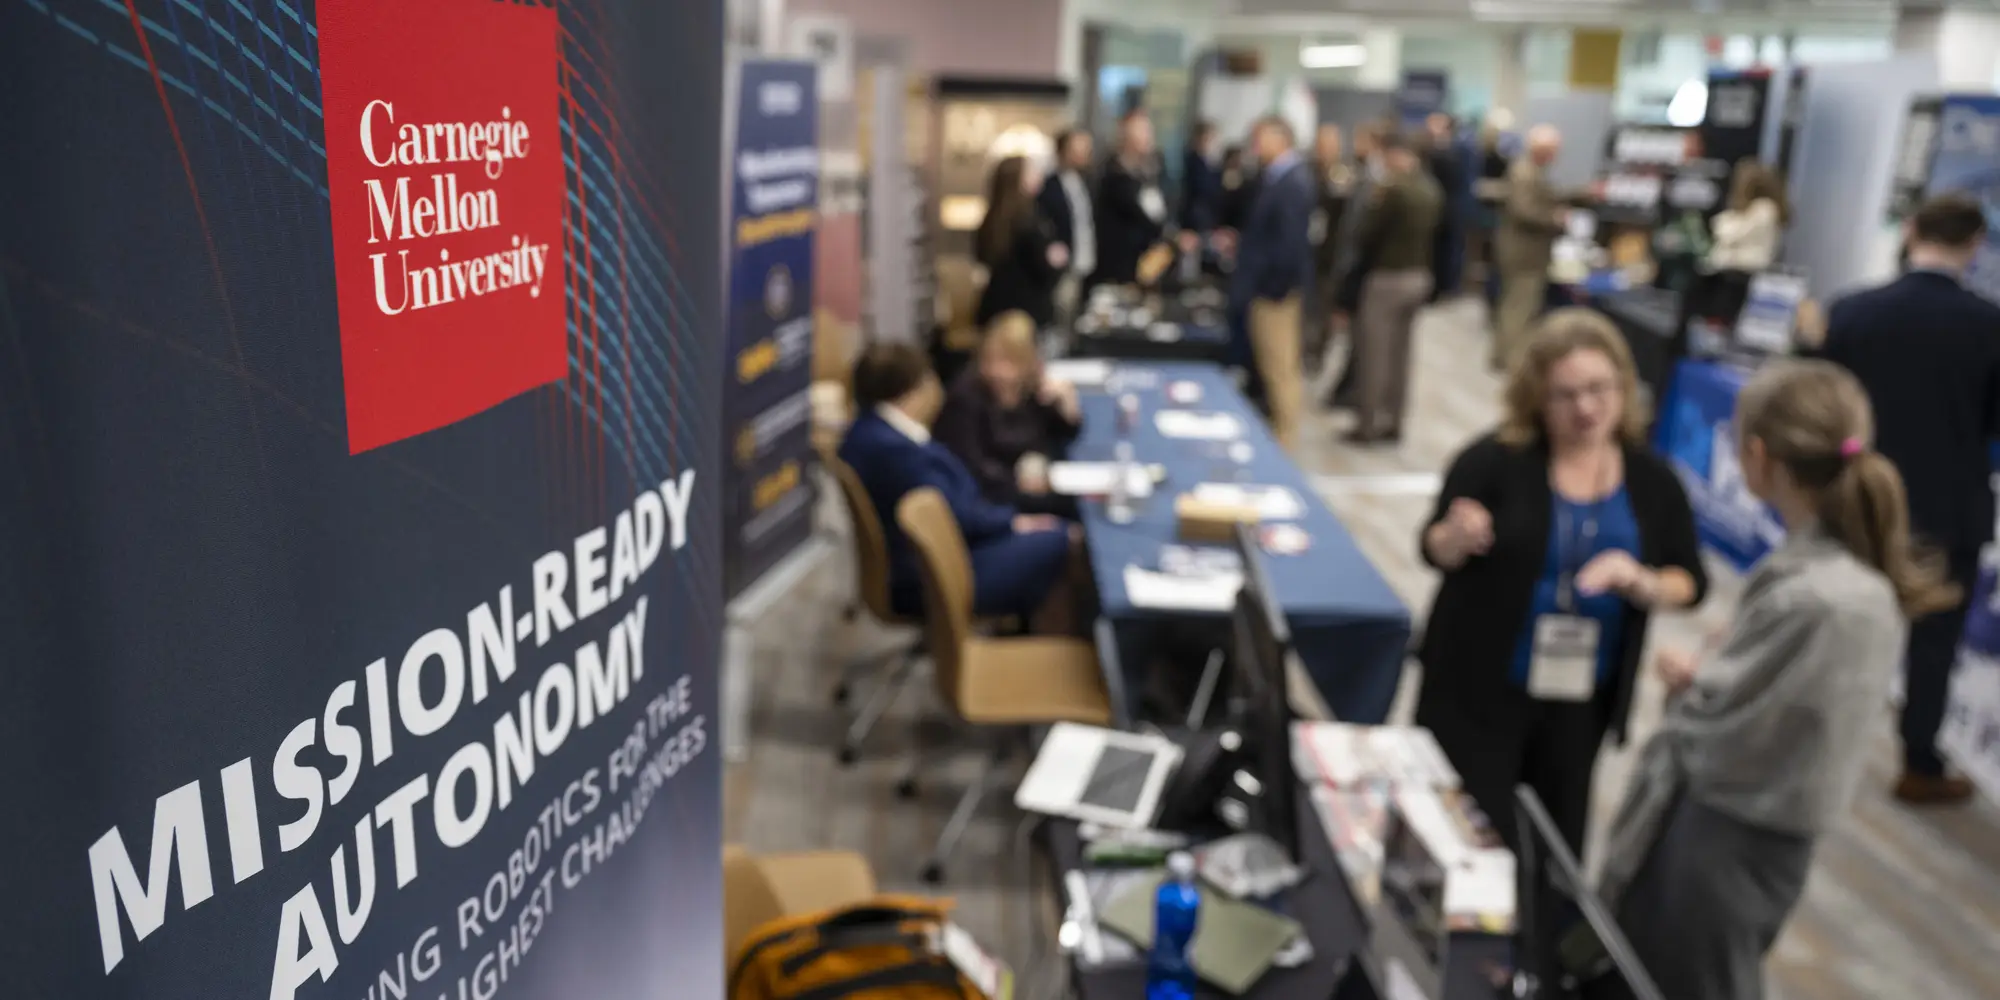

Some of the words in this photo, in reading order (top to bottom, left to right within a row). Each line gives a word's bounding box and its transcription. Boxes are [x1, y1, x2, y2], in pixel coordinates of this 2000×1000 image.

[360, 99, 529, 179] Carnegie
[363, 172, 500, 243] Mellon
[369, 234, 549, 315] University
[88, 469, 695, 975] MISSION-READY
[268, 596, 648, 1000] AUTONOMY
[367, 926, 441, 1000] NG
[457, 768, 600, 950] ROBOTICS
[608, 719, 647, 793] FOR
[646, 674, 692, 737] THE
[438, 868, 555, 1000] IGHEST
[561, 714, 706, 889] CHALLENGES
